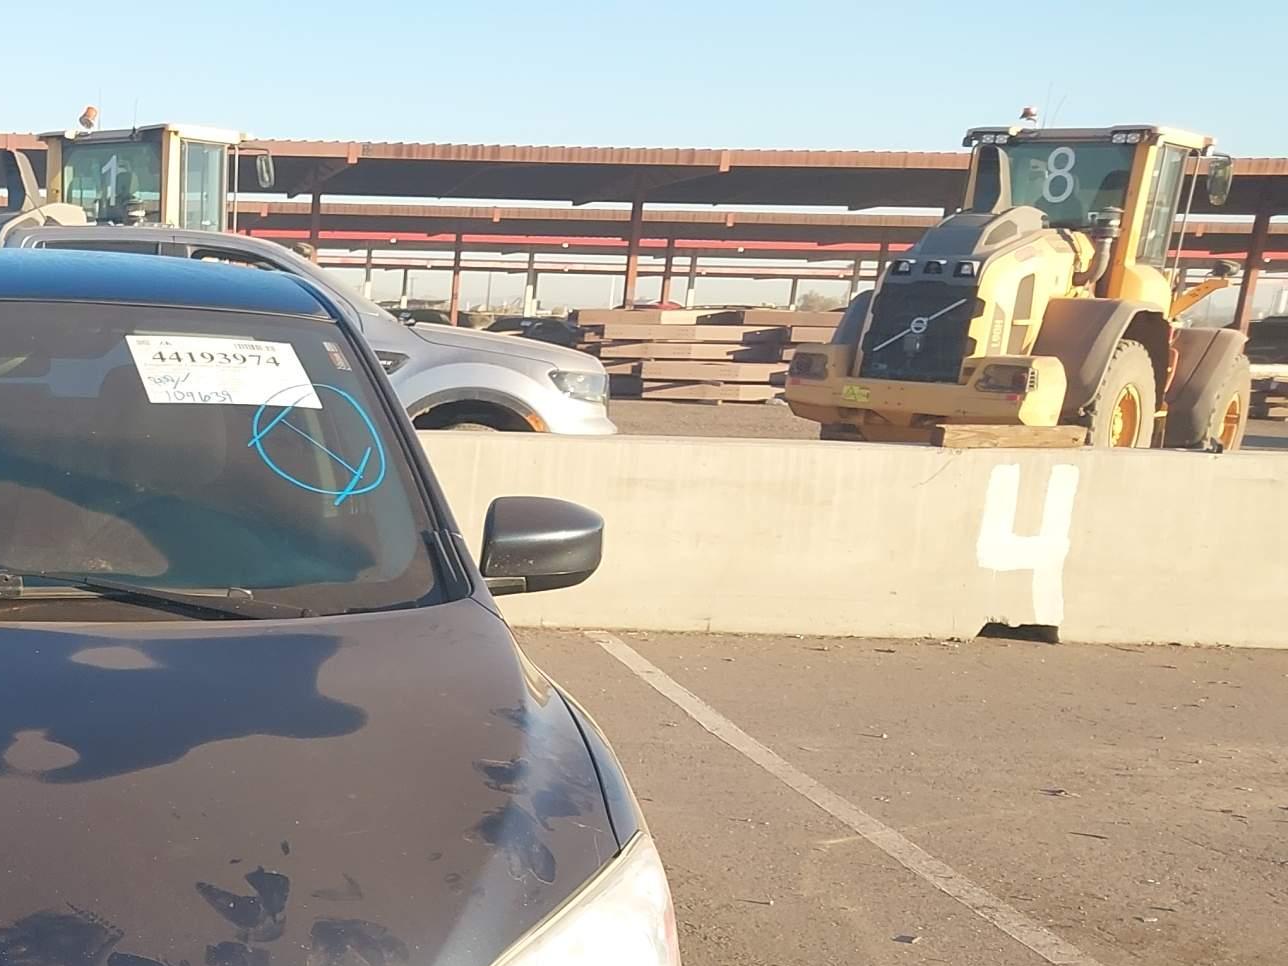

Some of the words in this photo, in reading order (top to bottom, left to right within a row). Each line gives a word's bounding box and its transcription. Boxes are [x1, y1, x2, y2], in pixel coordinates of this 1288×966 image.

[101, 154, 117, 206] 1
[1043, 146, 1076, 203] 8
[152, 350, 280, 368] 44193974
[976, 463, 1080, 626] 4
